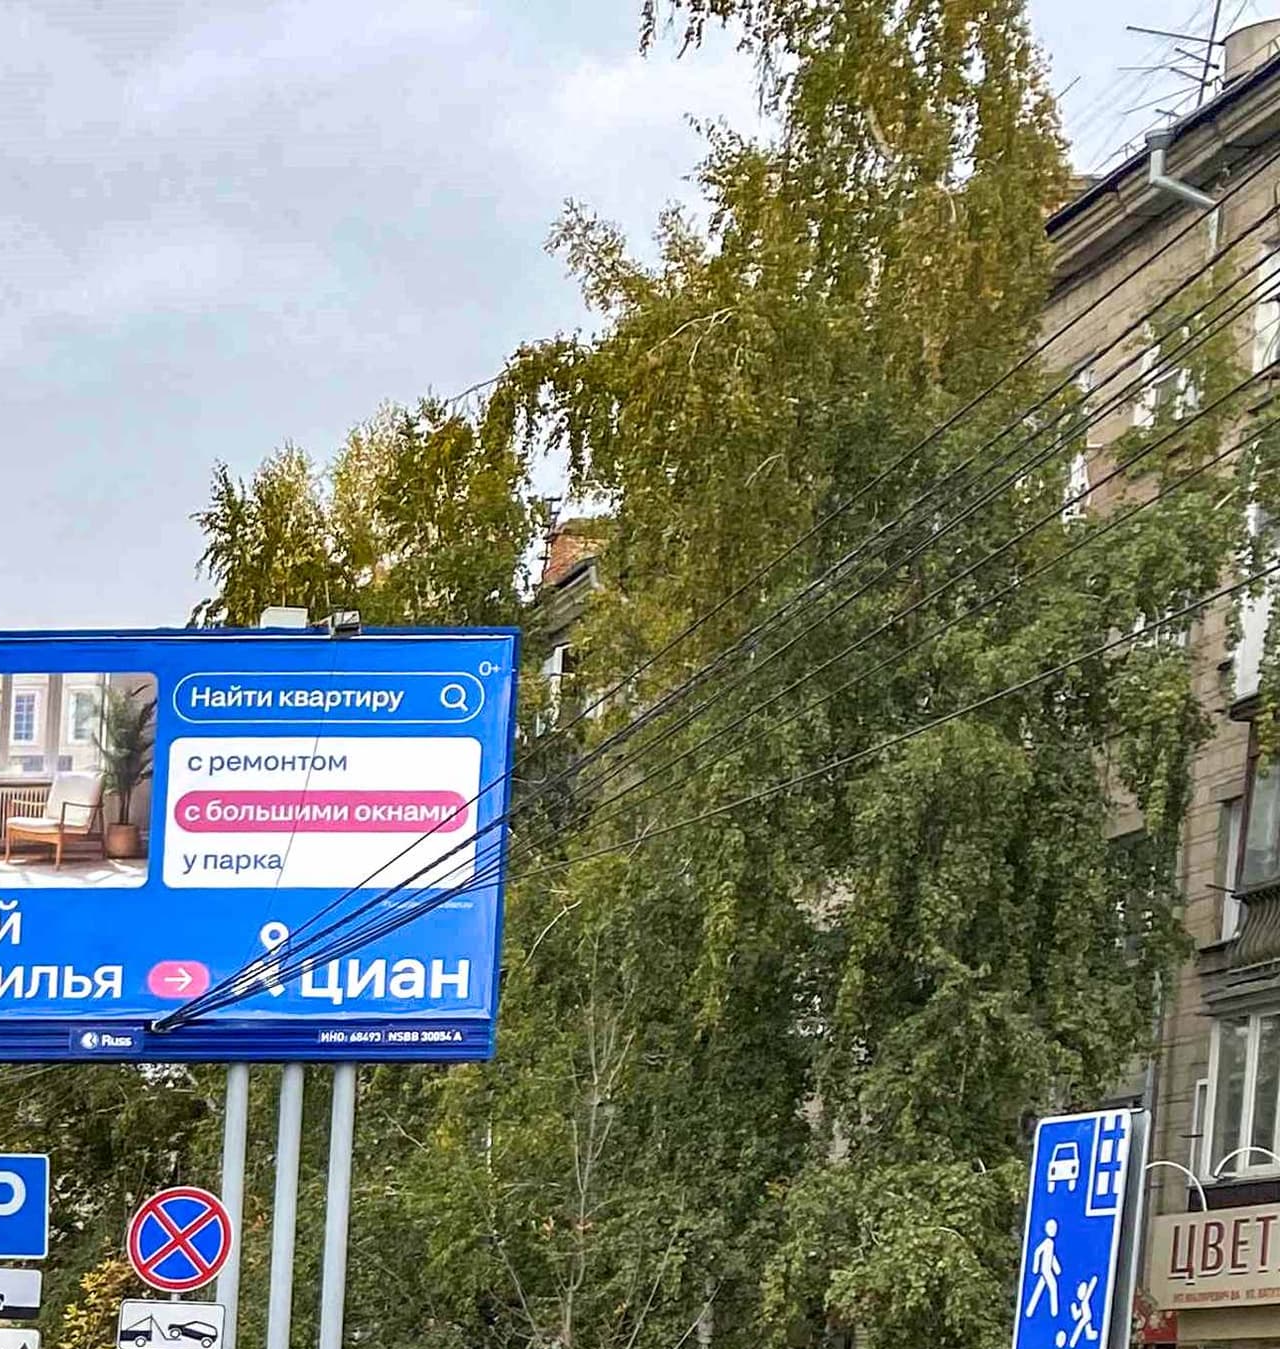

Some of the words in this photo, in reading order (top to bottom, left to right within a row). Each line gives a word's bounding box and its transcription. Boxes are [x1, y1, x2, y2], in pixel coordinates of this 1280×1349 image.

[478, 661, 501, 677] 0+
[190, 684, 273, 708] Найти
[278, 688, 405, 713] квартиру
[187, 756, 203, 771] с
[208, 755, 348, 776] ремонтом
[184, 805, 201, 821] с
[205, 800, 349, 821] большими
[354, 804, 458, 822] окнами
[182, 854, 197, 874] у
[202, 854, 284, 875] парка
[299, 956, 471, 1005] циан
[101, 1034, 133, 1047] Russ
